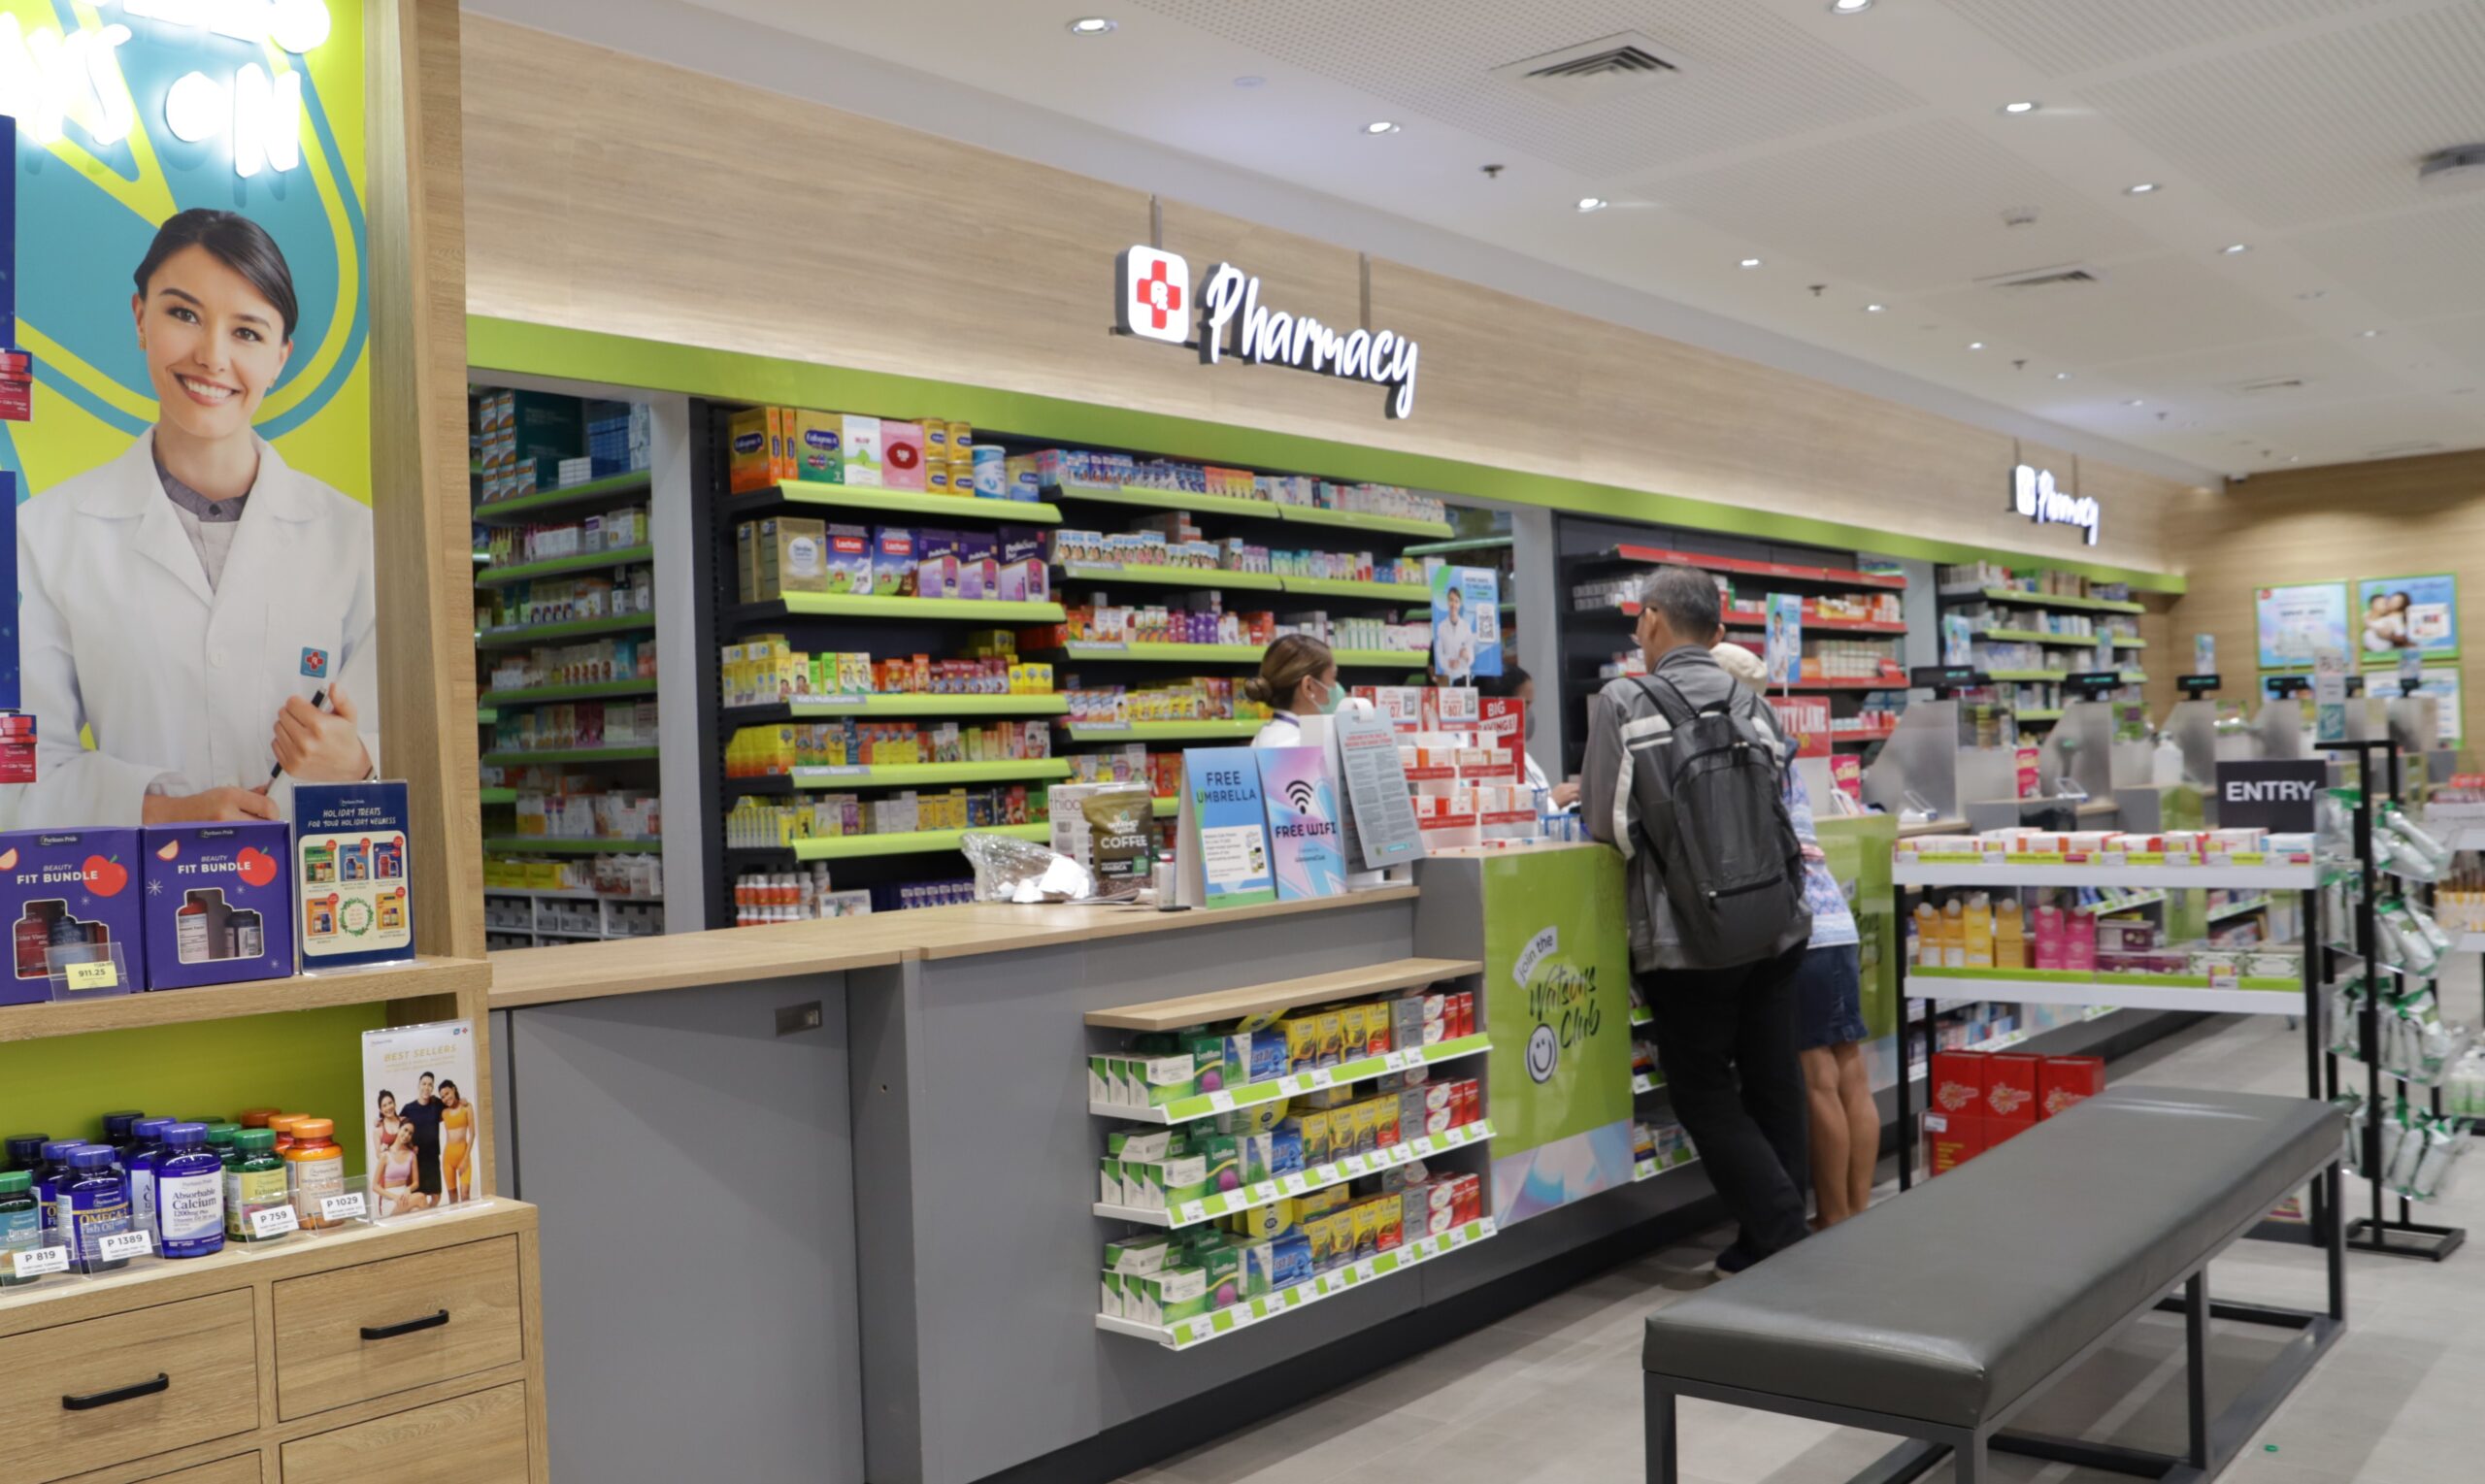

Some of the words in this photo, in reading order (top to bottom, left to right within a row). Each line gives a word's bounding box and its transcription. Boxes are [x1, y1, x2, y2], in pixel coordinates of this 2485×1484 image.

[165, 62, 301, 178] ON
[1206, 261, 1418, 420] Pharmacy
[1487, 701, 1506, 716] BIG
[1207, 771, 1242, 786] FREE
[1197, 788, 1257, 804] UMBRELLA
[2226, 780, 2316, 802] ENTRY
[323, 808, 354, 817] HOLIDAY
[1276, 824, 1305, 839] FREE
[1307, 822, 1338, 836] WIFI
[1101, 835, 1147, 849] COFFEE
[178, 864, 197, 874] FIT
[201, 862, 251, 873] BUNDLE
[17, 874, 39, 884] FIT
[44, 871, 98, 882] BUNDLE
[1537, 935, 1553, 952] the
[78, 969, 106, 977] 911.25
[1530, 965, 1597, 1021] Watsons
[1561, 999, 1600, 1049] Club
[384, 1051, 410, 1062] BEST
[414, 1044, 457, 1057] SELLERS
[173, 1188, 215, 1200] Absorbable
[336, 1196, 358, 1206] 1029
[173, 1198, 216, 1209] Calcium
[270, 1211, 287, 1220] 759
[102, 1222, 115, 1231] Oil
[117, 1235, 143, 1245] 1389
[37, 1251, 55, 1261] 819
